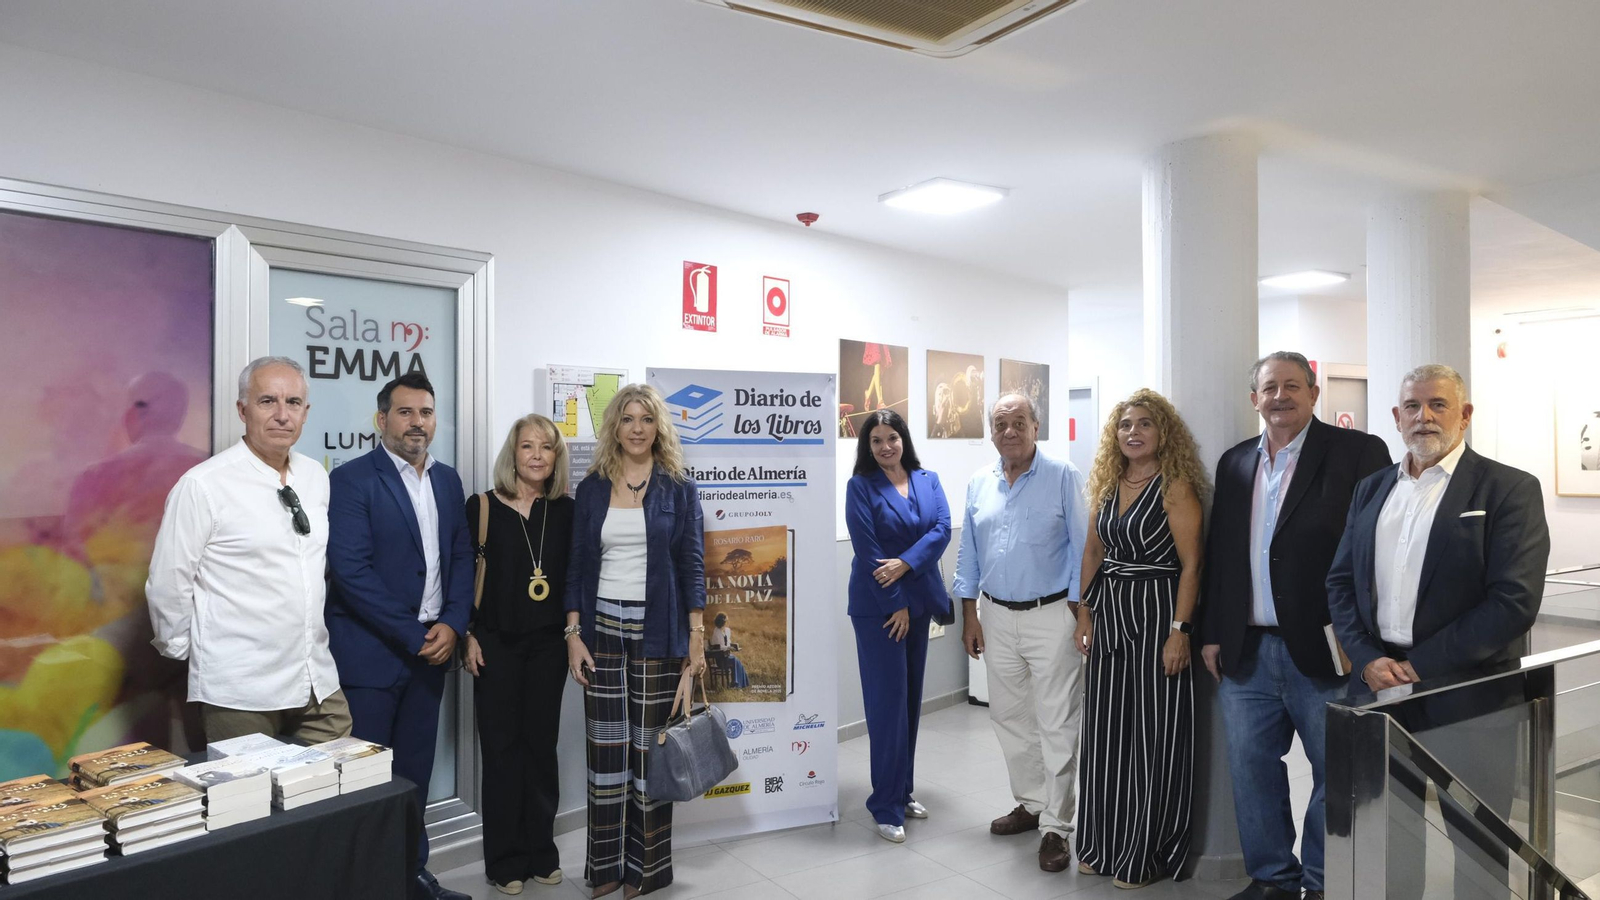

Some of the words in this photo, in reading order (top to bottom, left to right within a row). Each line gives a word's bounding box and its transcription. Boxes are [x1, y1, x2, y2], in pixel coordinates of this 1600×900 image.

[305, 305, 381, 343] Sala
[684, 313, 715, 327] EXTINTOR
[306, 345, 430, 381] EMMA
[734, 388, 797, 407] Diario
[800, 390, 822, 407] de
[734, 414, 761, 435] los
[766, 413, 822, 441] Libros
[324, 432, 382, 449] LUM
[728, 466, 746, 481] de
[747, 465, 807, 480] Almería
[713, 536, 744, 546] ROSARIO
[744, 534, 765, 543] RARO
[706, 576, 724, 589] LA
[727, 573, 773, 588] NOVIA
[706, 593, 724, 605] DE
[725, 593, 742, 604] LA
[744, 589, 773, 603] PAZ
[743, 717, 776, 725] UNIVERSIDAD
[743, 745, 774, 755] ALMERÍA
[765, 776, 784, 785] BIBA
[714, 784, 750, 795] GAZQUEZ
